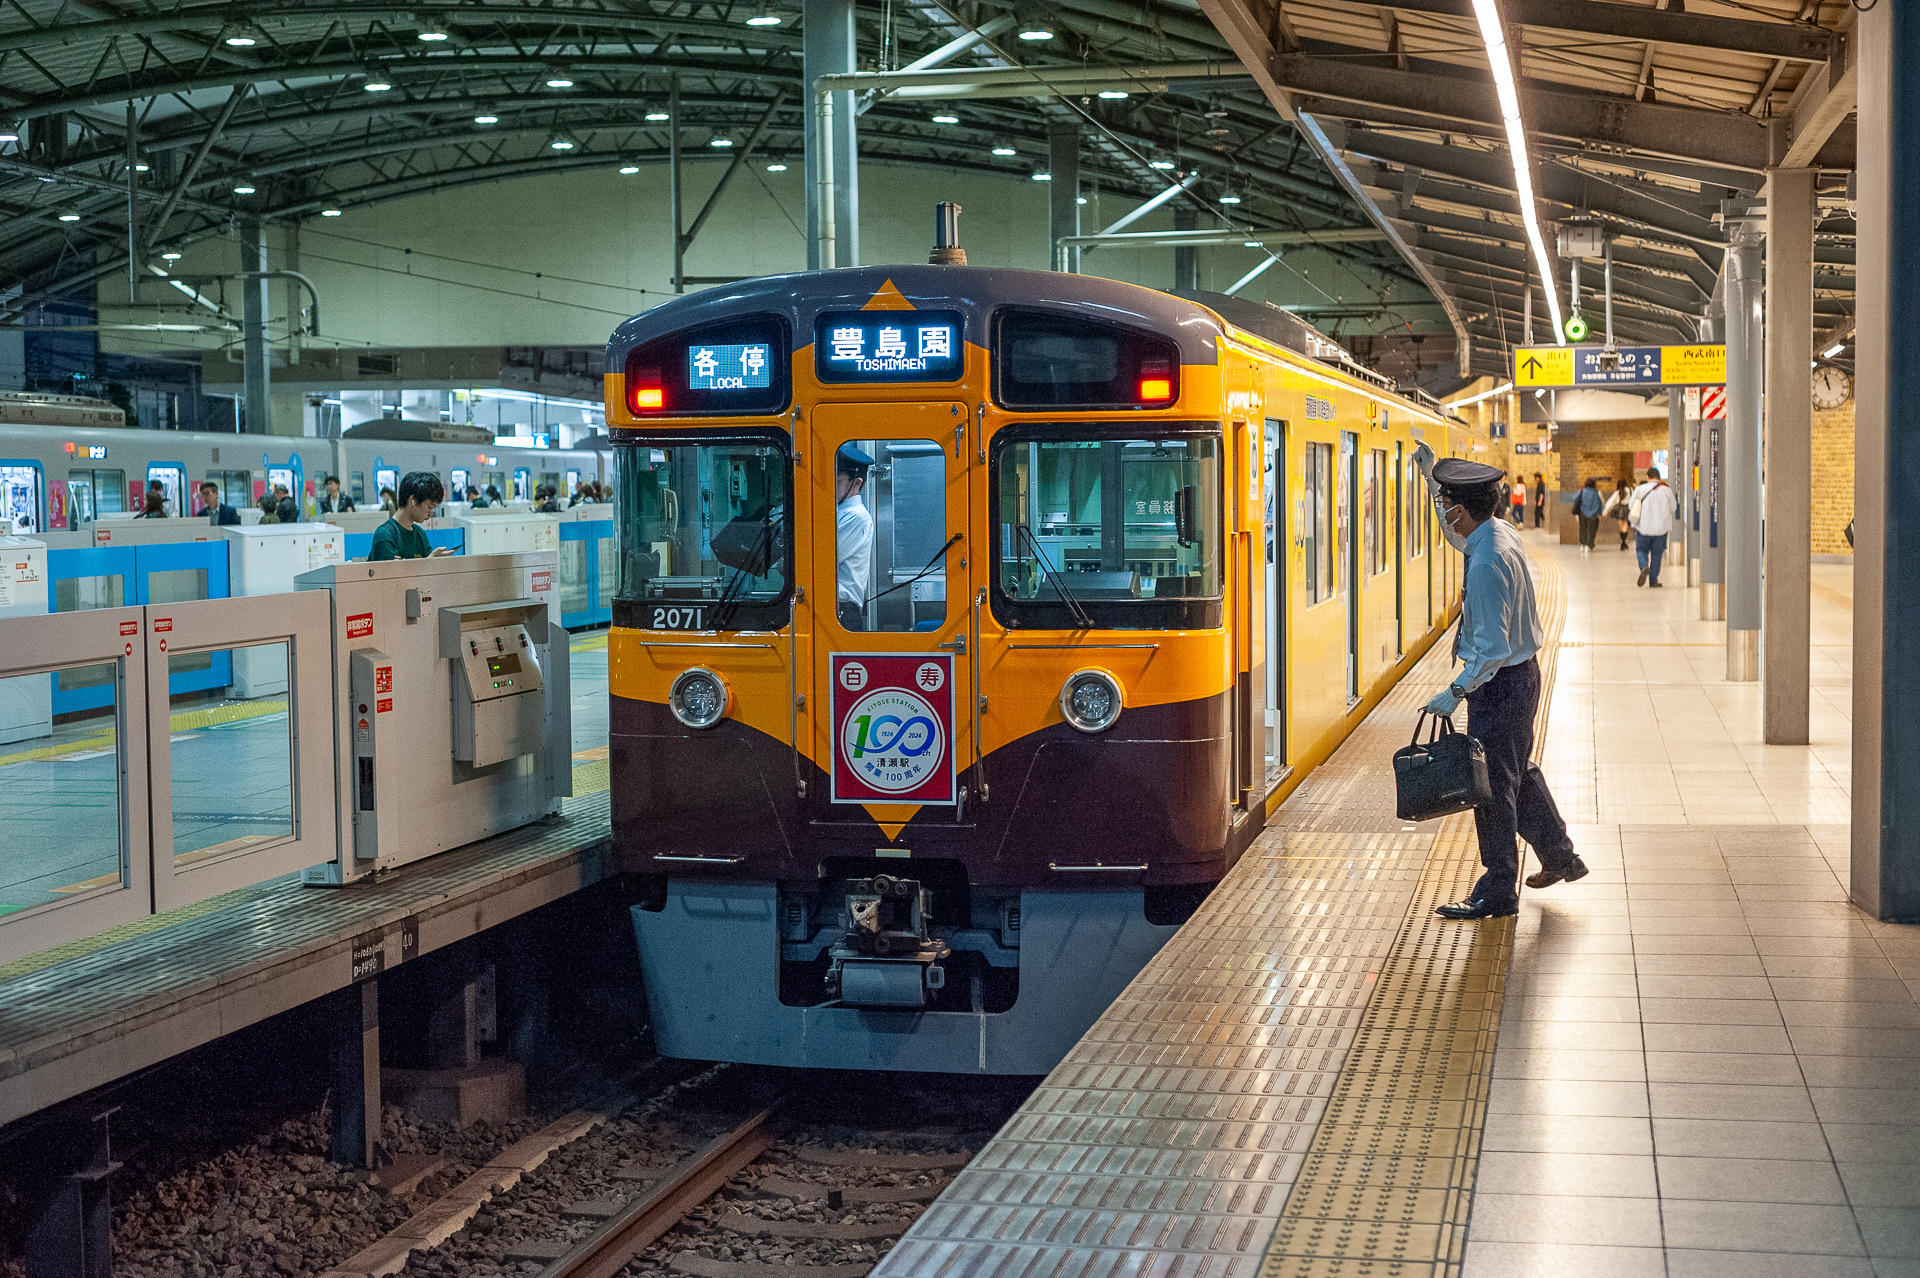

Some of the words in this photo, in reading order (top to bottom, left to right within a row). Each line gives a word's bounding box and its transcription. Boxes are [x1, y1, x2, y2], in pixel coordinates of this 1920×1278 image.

[831, 327, 950, 360] 豊島園
[694, 346, 765, 377] 各停
[855, 358, 926, 371] TOSHIMAEN
[710, 377, 748, 389] LOCAL
[653, 608, 702, 629] 2071
[844, 667, 863, 686] 百
[920, 667, 940, 687] 寿
[867, 698, 890, 713] KIYOSE
[891, 698, 919, 714] STATION
[876, 757, 910, 768] 清瀬駅
